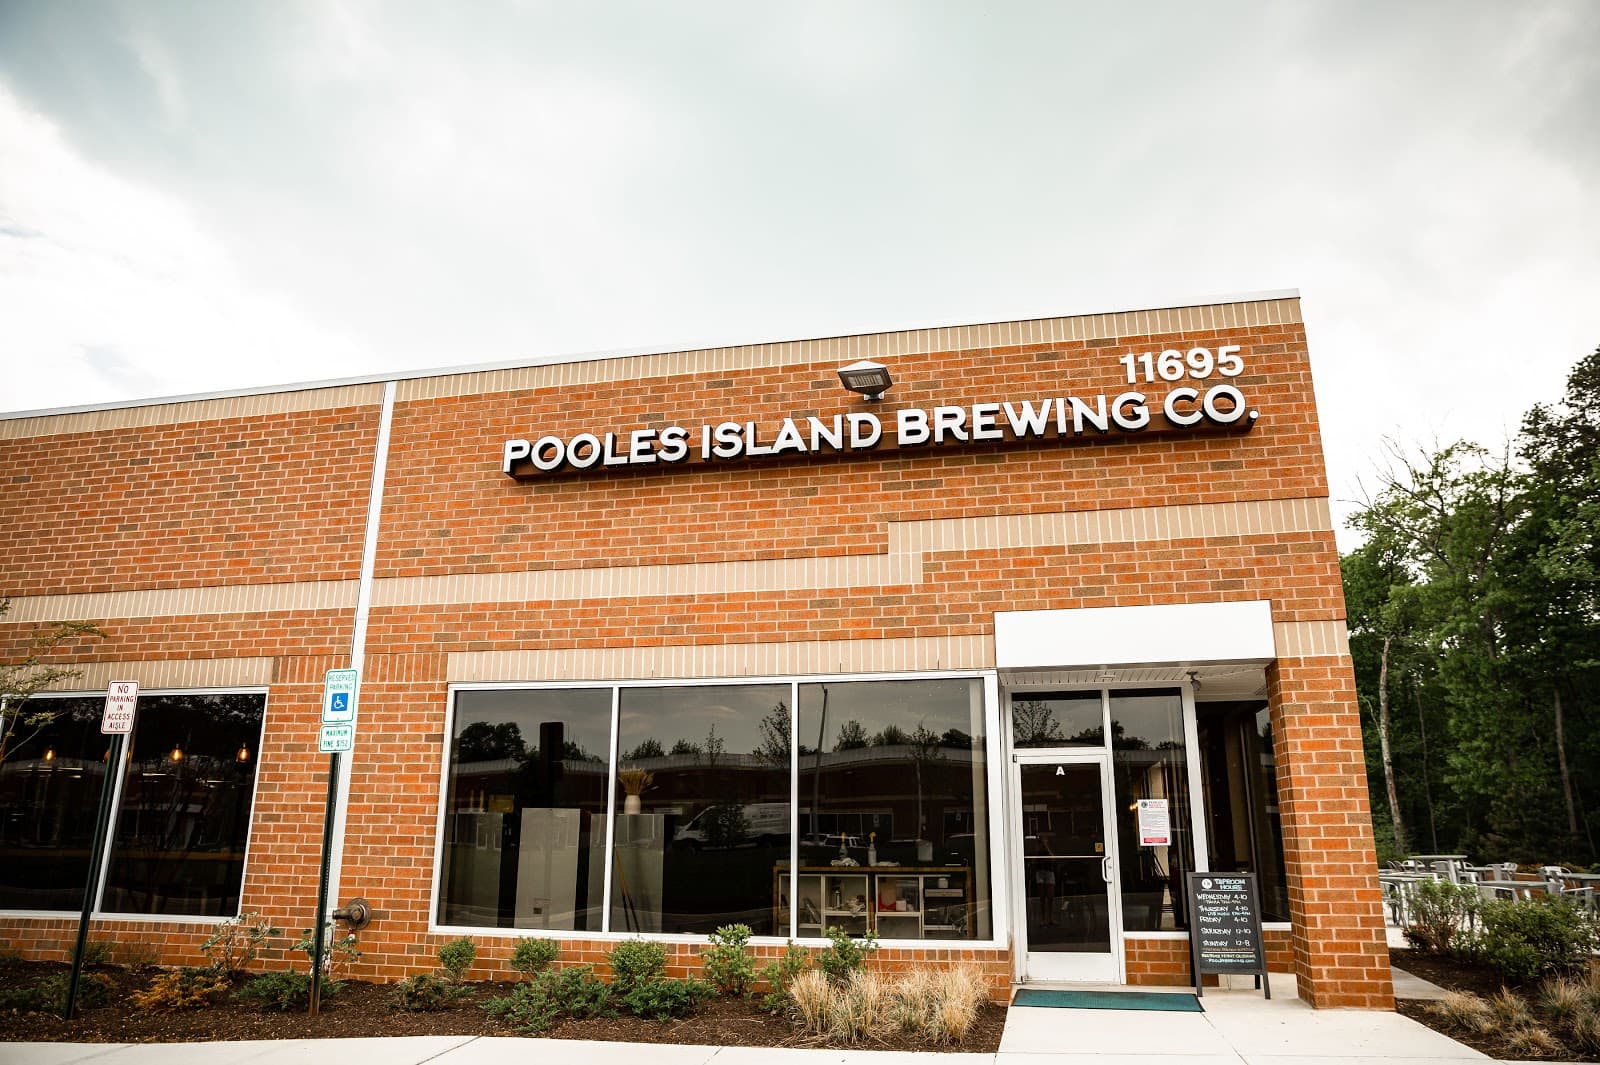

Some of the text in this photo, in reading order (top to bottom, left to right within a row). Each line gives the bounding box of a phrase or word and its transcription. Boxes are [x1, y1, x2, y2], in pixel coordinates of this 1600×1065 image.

[1120, 345, 1245, 384] 11695
[503, 384, 1260, 474] POOLES ISLAND BREWING CO.
[117, 685, 129, 694] NO
[109, 722, 125, 730] AISLE
[1055, 766, 1066, 776] A
[1200, 927, 1232, 936] SATURDAY
[1202, 939, 1229, 947] SUNDAY
